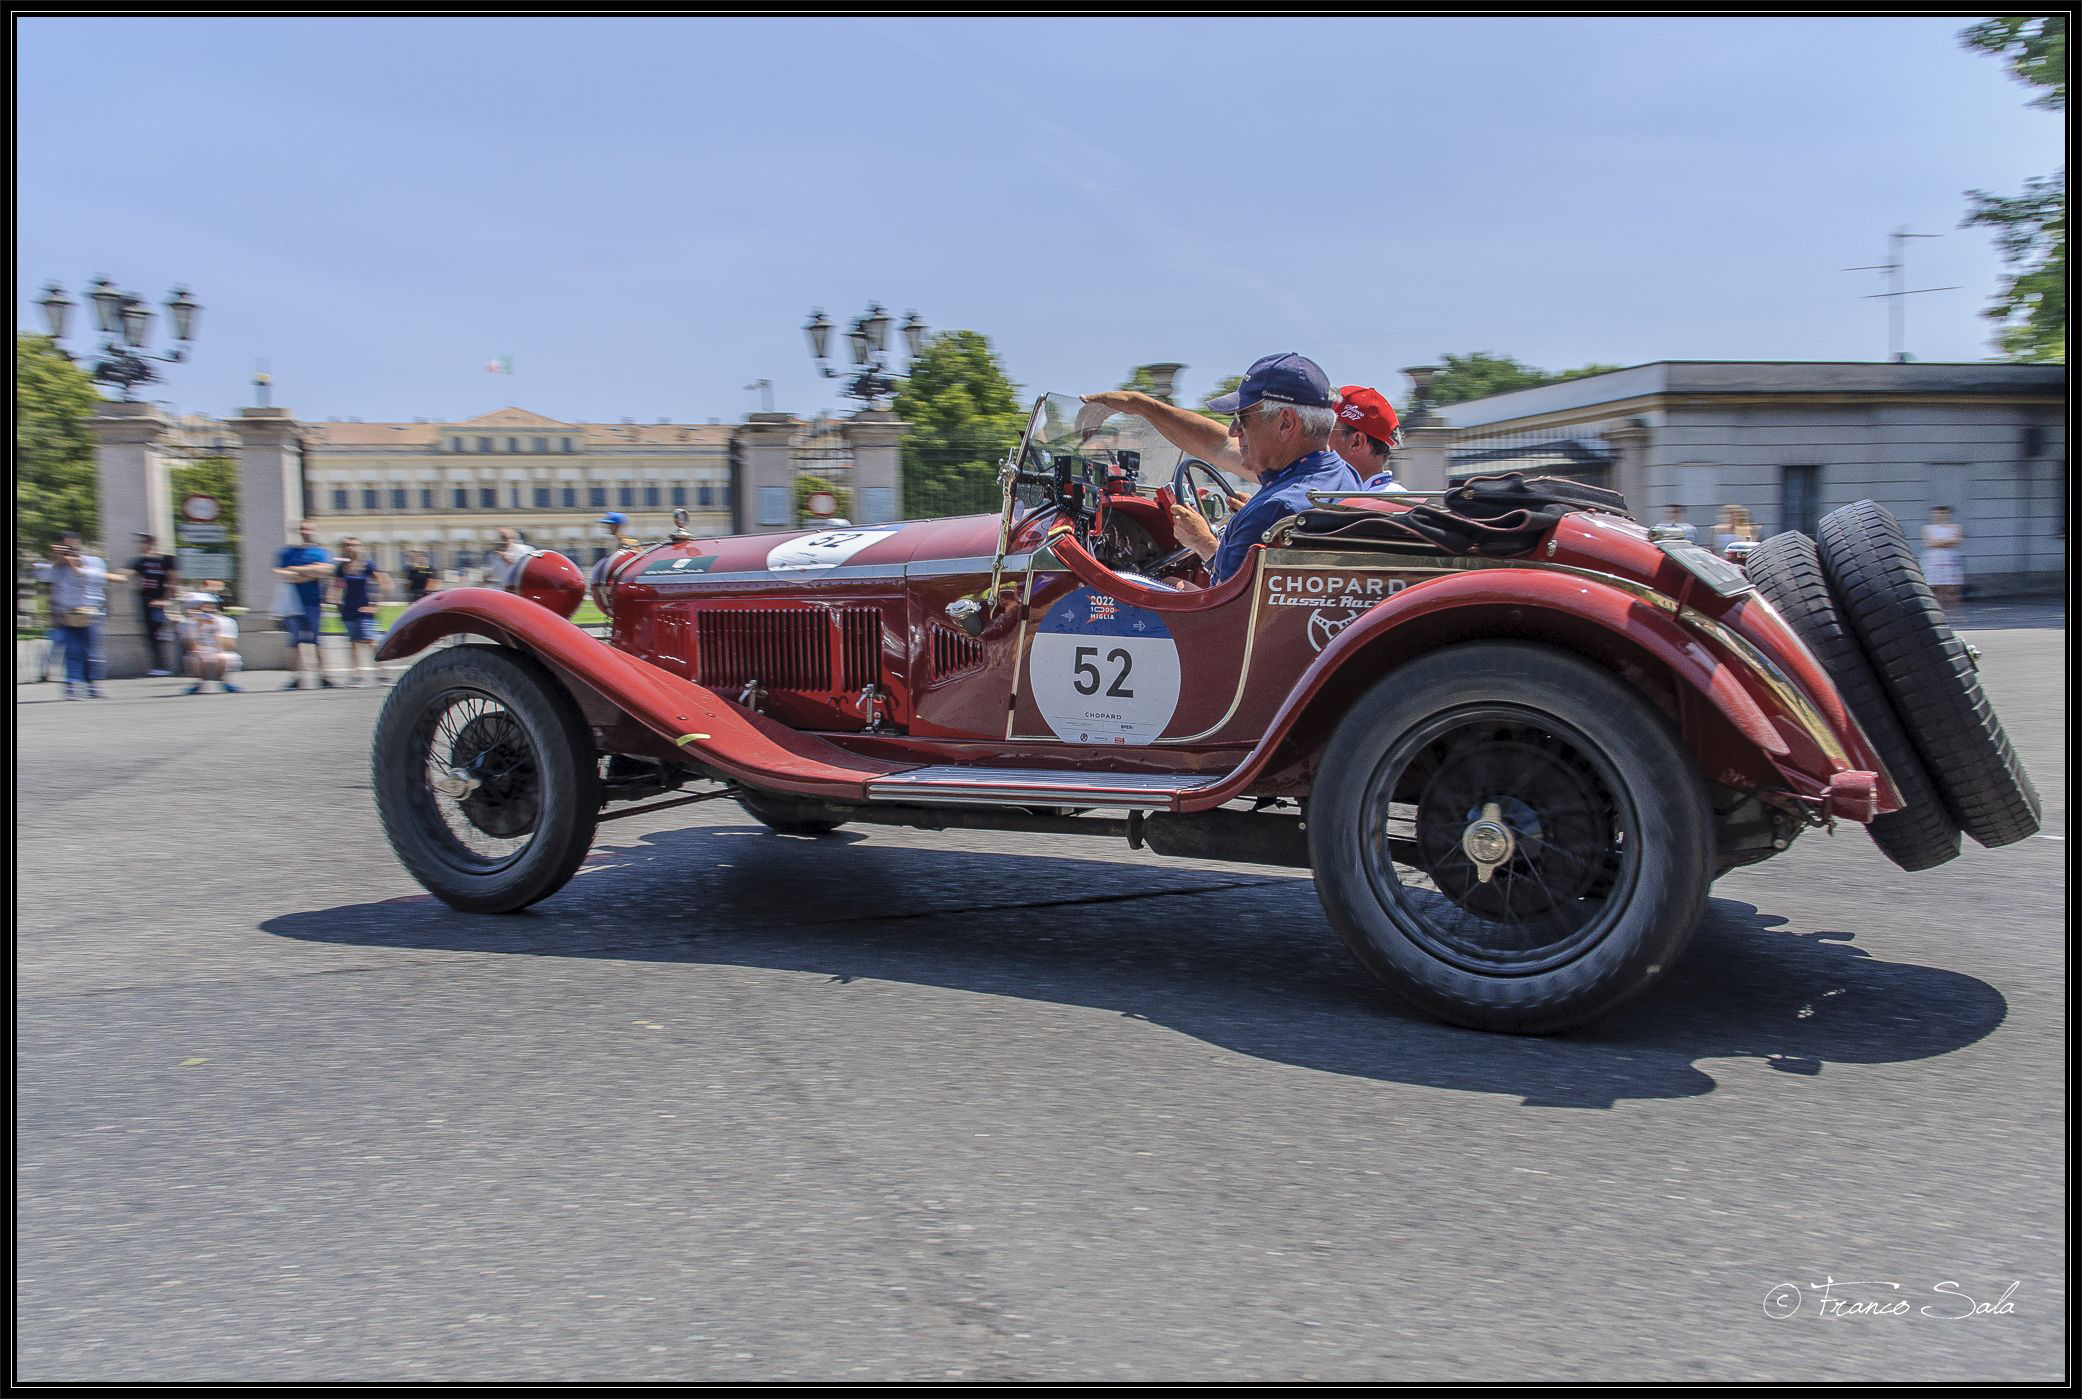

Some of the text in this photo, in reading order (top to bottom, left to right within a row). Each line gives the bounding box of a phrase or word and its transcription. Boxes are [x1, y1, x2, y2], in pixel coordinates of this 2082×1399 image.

[808, 533, 864, 548] 52
[1268, 575, 1407, 595] CHOPARD
[1090, 595, 1115, 606] 2022
[1268, 593, 1337, 606] Classic
[1073, 646, 1134, 699] 52
[1085, 712, 1122, 720] CHOPARD
